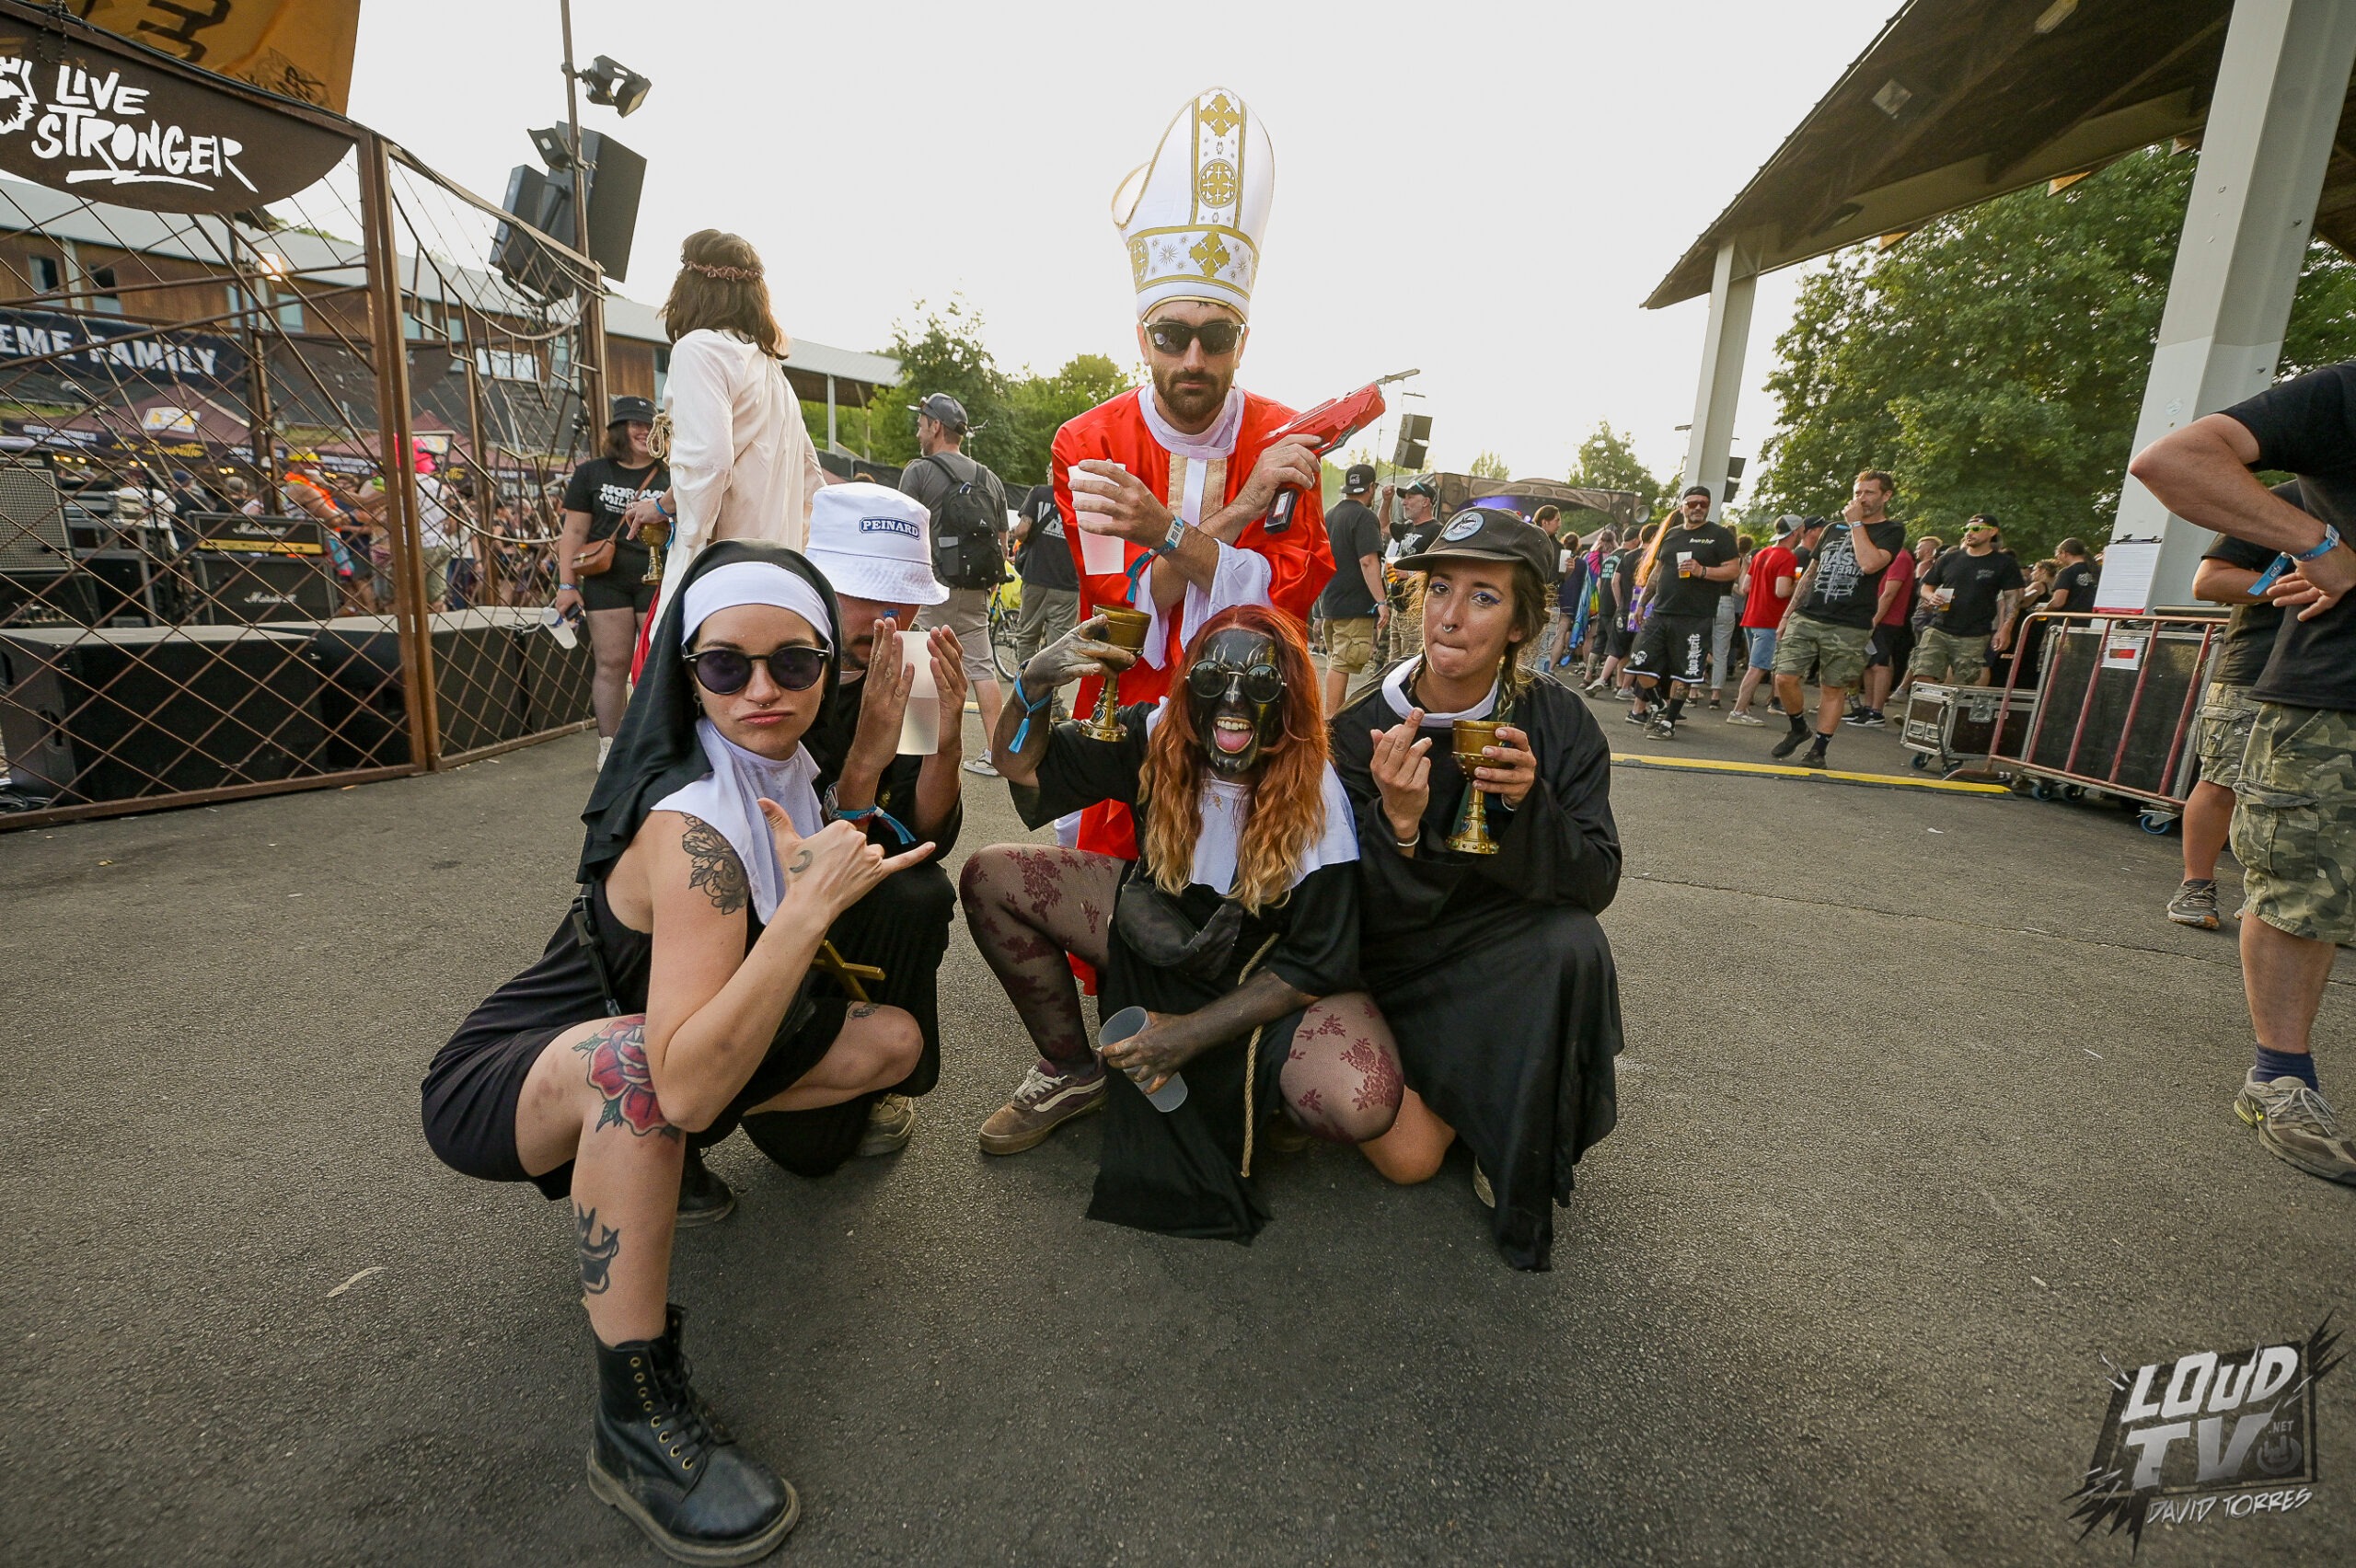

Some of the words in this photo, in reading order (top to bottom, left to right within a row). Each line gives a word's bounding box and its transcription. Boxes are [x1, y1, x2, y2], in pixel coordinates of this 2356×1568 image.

[55, 64, 150, 115] LIVE
[30, 103, 259, 193] STRONGER
[87, 334, 217, 376] FAMILY
[862, 520, 918, 536] PEINARD
